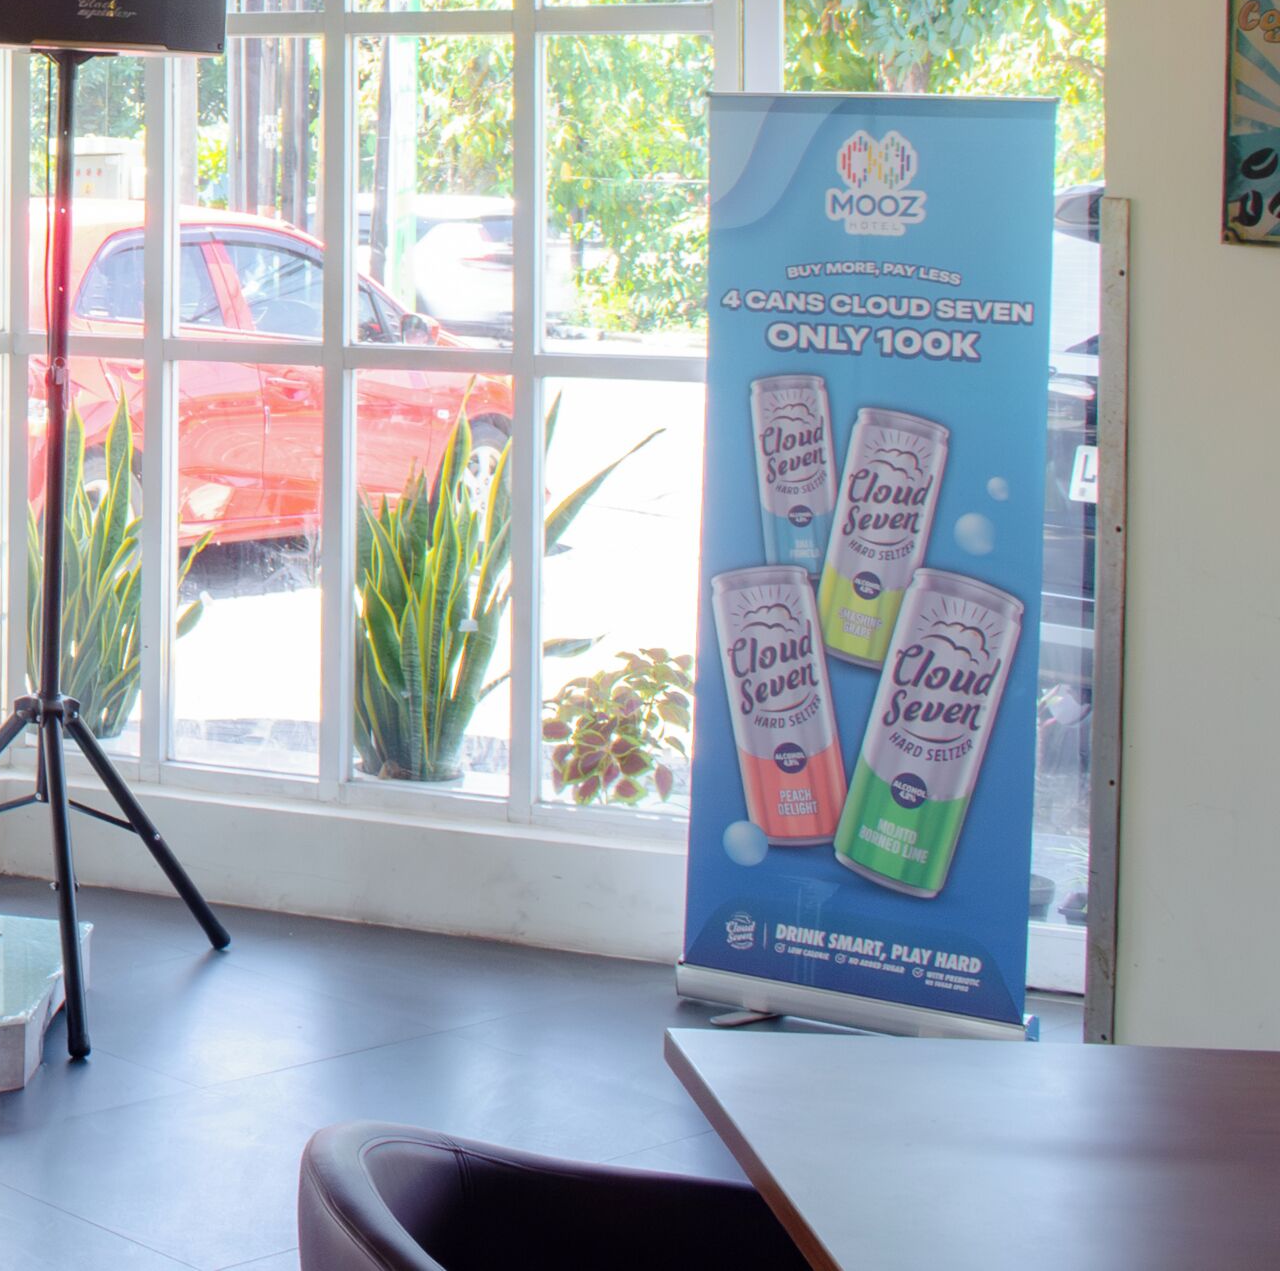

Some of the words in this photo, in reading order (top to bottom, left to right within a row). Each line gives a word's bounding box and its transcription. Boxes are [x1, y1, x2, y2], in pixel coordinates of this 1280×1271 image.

[832, 194, 920, 217] MOOZ
[785, 263, 822, 280] BUY
[825, 261, 880, 278] MORE,
[882, 262, 917, 279] PAY
[918, 266, 962, 285] LESS
[721, 290, 741, 309] 4
[744, 289, 826, 314] CANS
[829, 294, 931, 319] CLOUD
[935, 299, 1034, 325] SEVEN
[766, 321, 871, 355] ONLY
[874, 327, 981, 362] 100K
[759, 416, 824, 456] Cloud
[766, 448, 826, 484] Seven
[848, 469, 933, 506] Cloud
[842, 505, 920, 536] Seven
[849, 539, 875, 559] HARD
[878, 540, 915, 561] SELTZER
[728, 620, 813, 678] Cloud
[893, 644, 1001, 696] Cloud
[741, 663, 818, 715] Seven
[754, 715, 785, 728] HARD
[790, 693, 821, 727] SELTZER
[882, 689, 981, 731] Seven
[889, 731, 921, 757] HARD
[925, 739, 973, 762] SELTZER
[778, 801, 818, 816] DELIGHT
[780, 789, 812, 802] PEACH
[878, 818, 917, 844] MOJITO
[775, 923, 826, 947] DRINK
[828, 932, 886, 961] SMART,
[891, 944, 933, 966] PLAY
[935, 951, 982, 974] HARD
